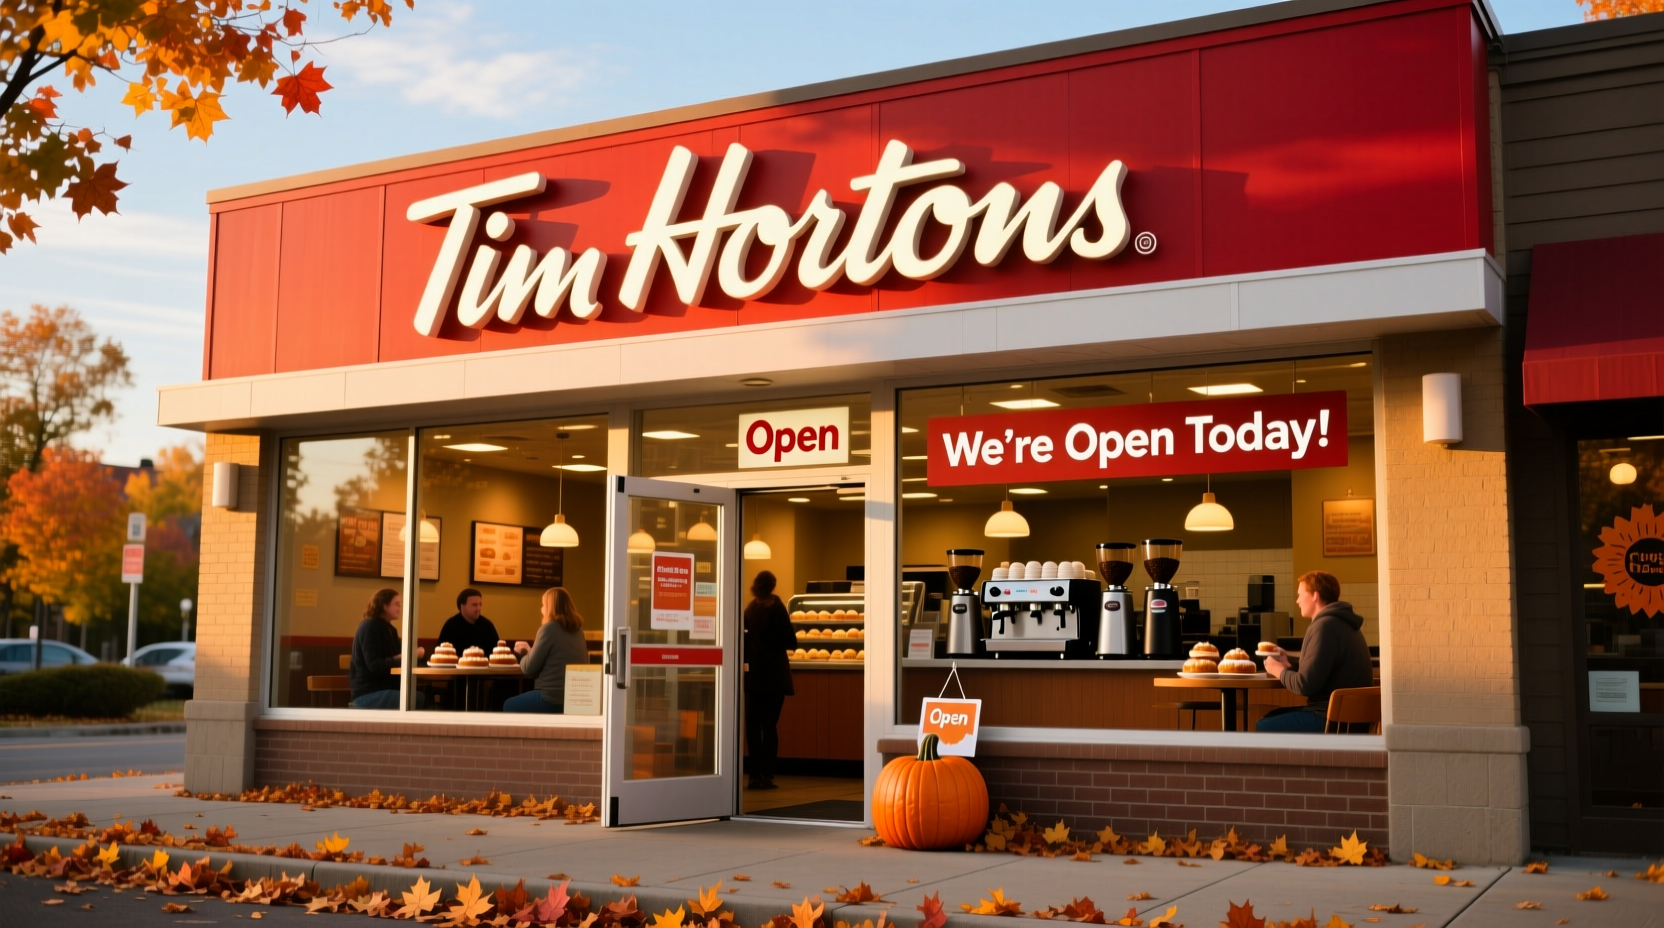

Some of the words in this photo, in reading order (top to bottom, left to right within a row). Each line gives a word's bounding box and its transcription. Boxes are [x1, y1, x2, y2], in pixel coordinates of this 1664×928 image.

[406, 172, 604, 338] Tim
[619, 139, 1131, 312] Hortons
[746, 419, 839, 463] Open
[942, 429, 1054, 468] We're
[1065, 422, 1174, 469] Open
[1185, 409, 1330, 460] Today!
[929, 707, 969, 729] Open
